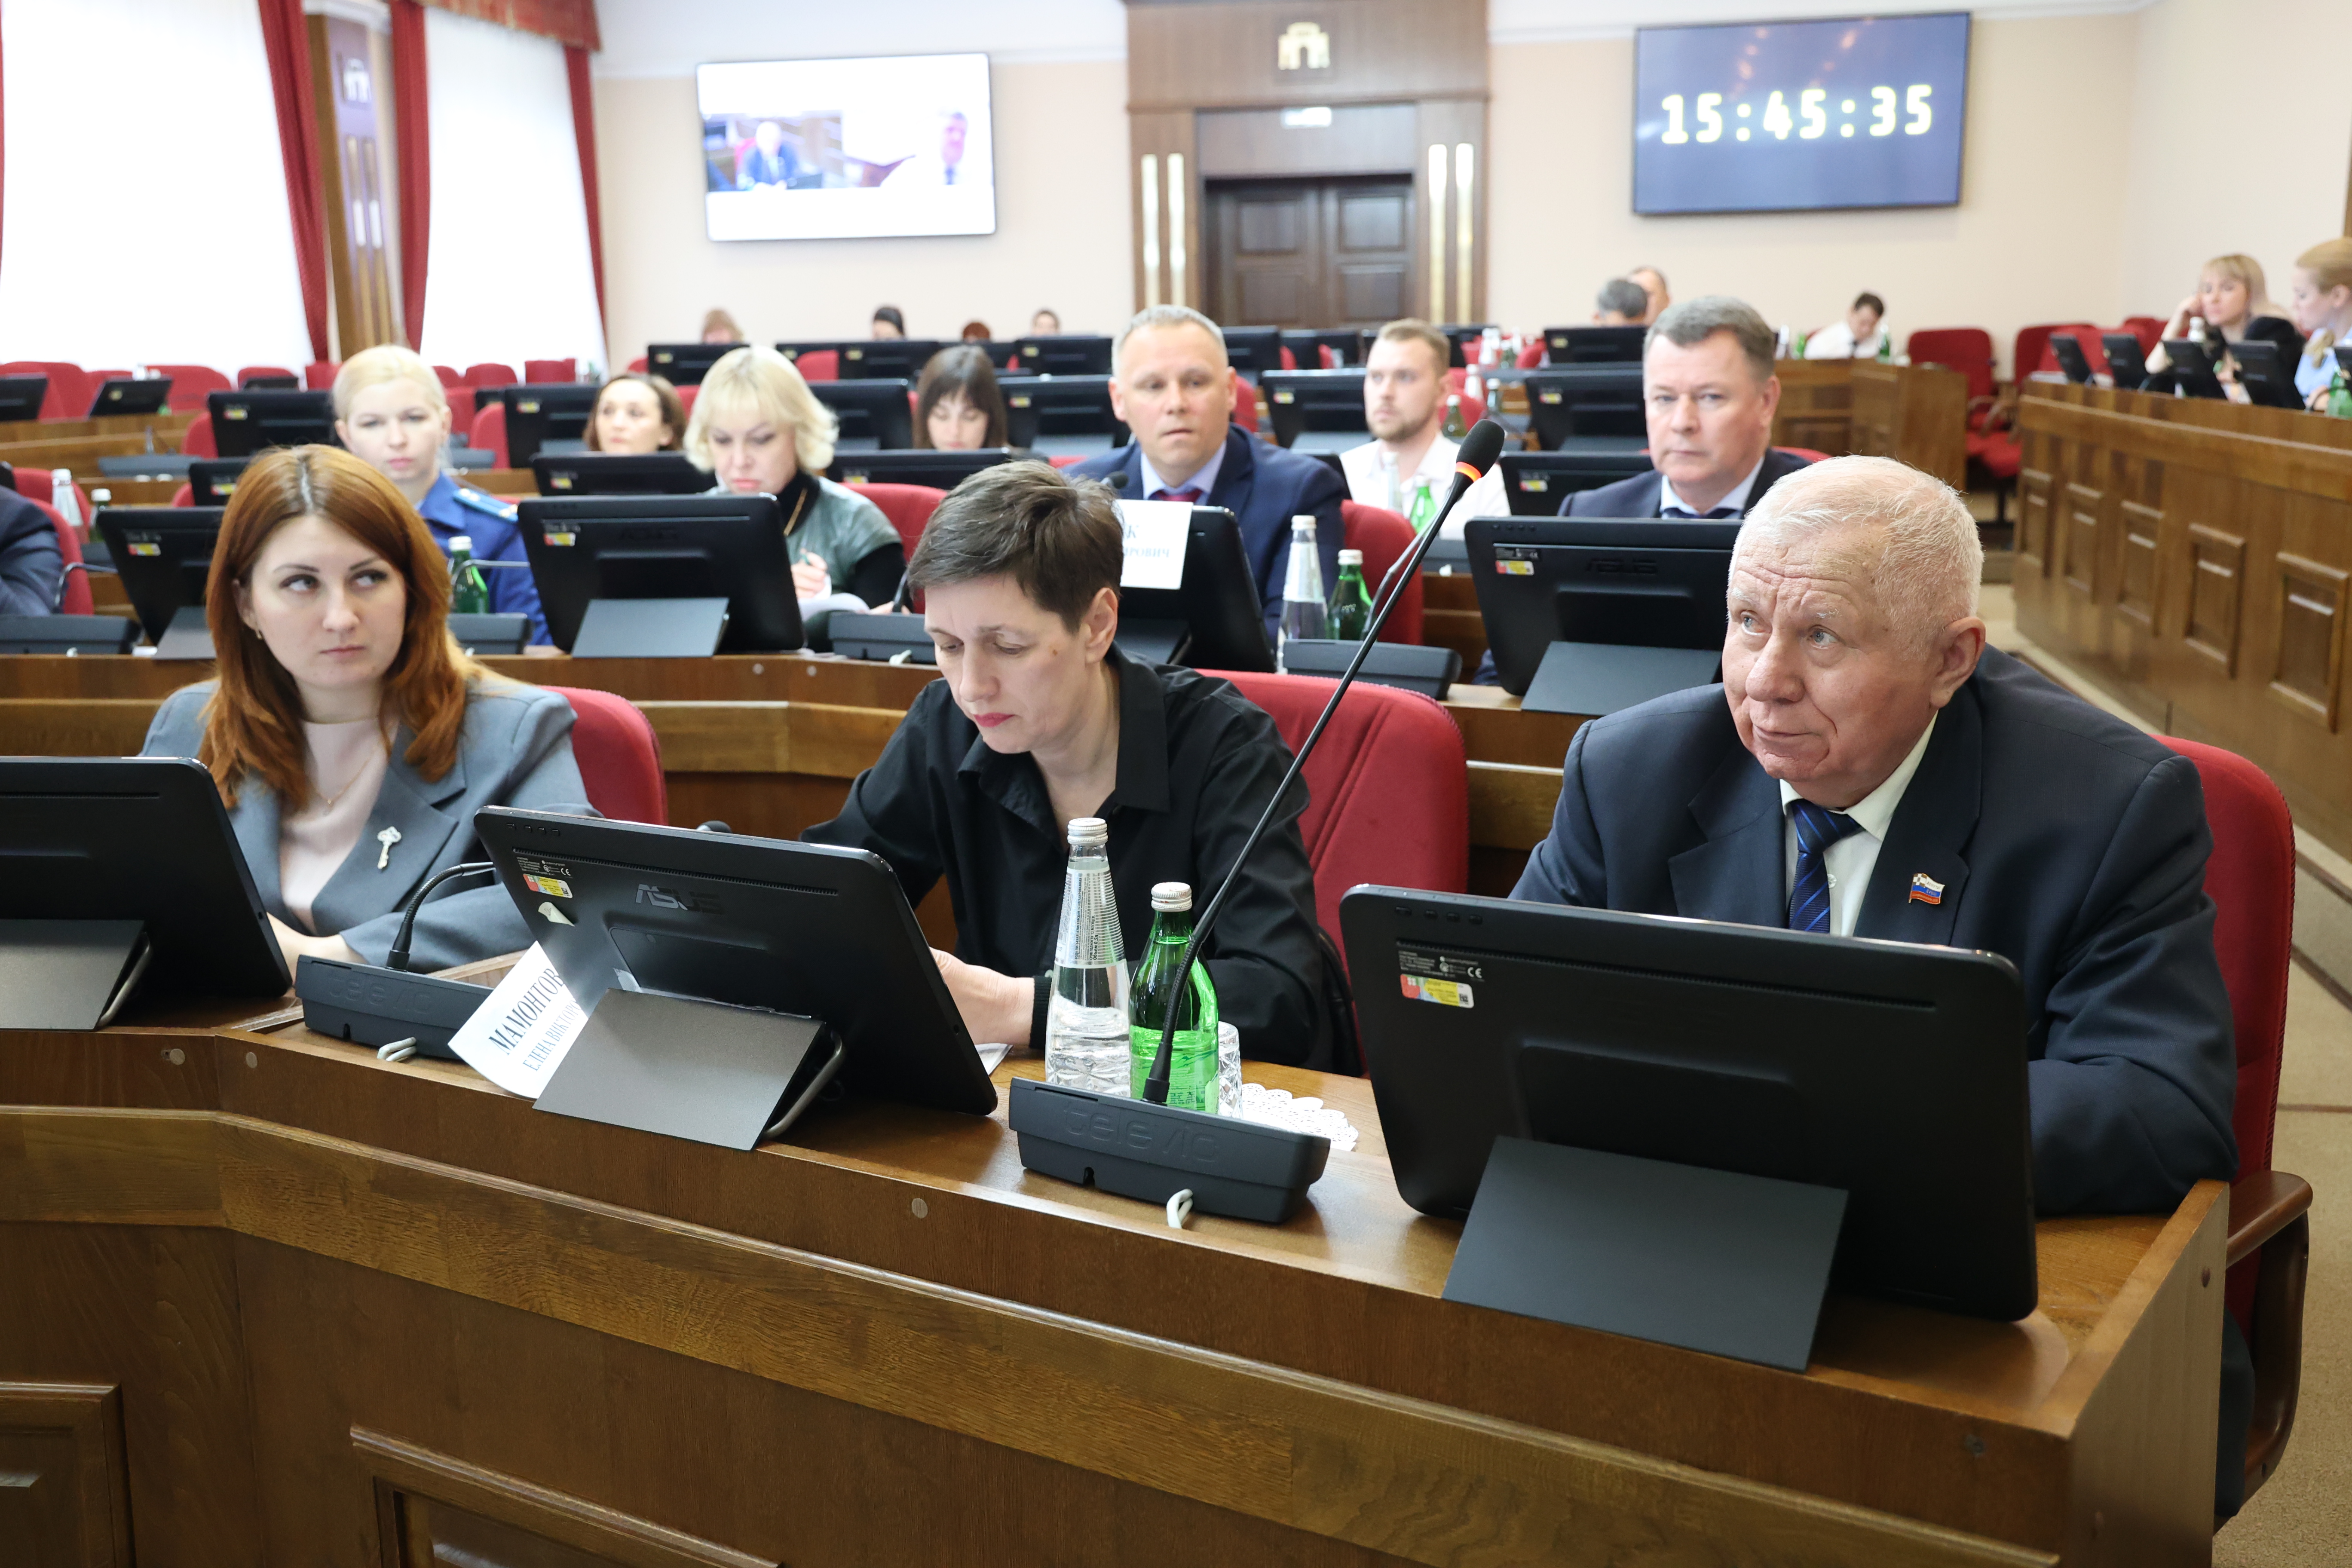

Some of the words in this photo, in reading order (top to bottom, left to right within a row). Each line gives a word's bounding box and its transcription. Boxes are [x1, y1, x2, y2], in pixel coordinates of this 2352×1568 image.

[1660, 83, 1933, 145] 15:45:35
[635, 884, 726, 915] ASUS
[488, 968, 565, 1056] МАМОНТОВ
[523, 1039, 556, 1071] ЕЛЕНА
